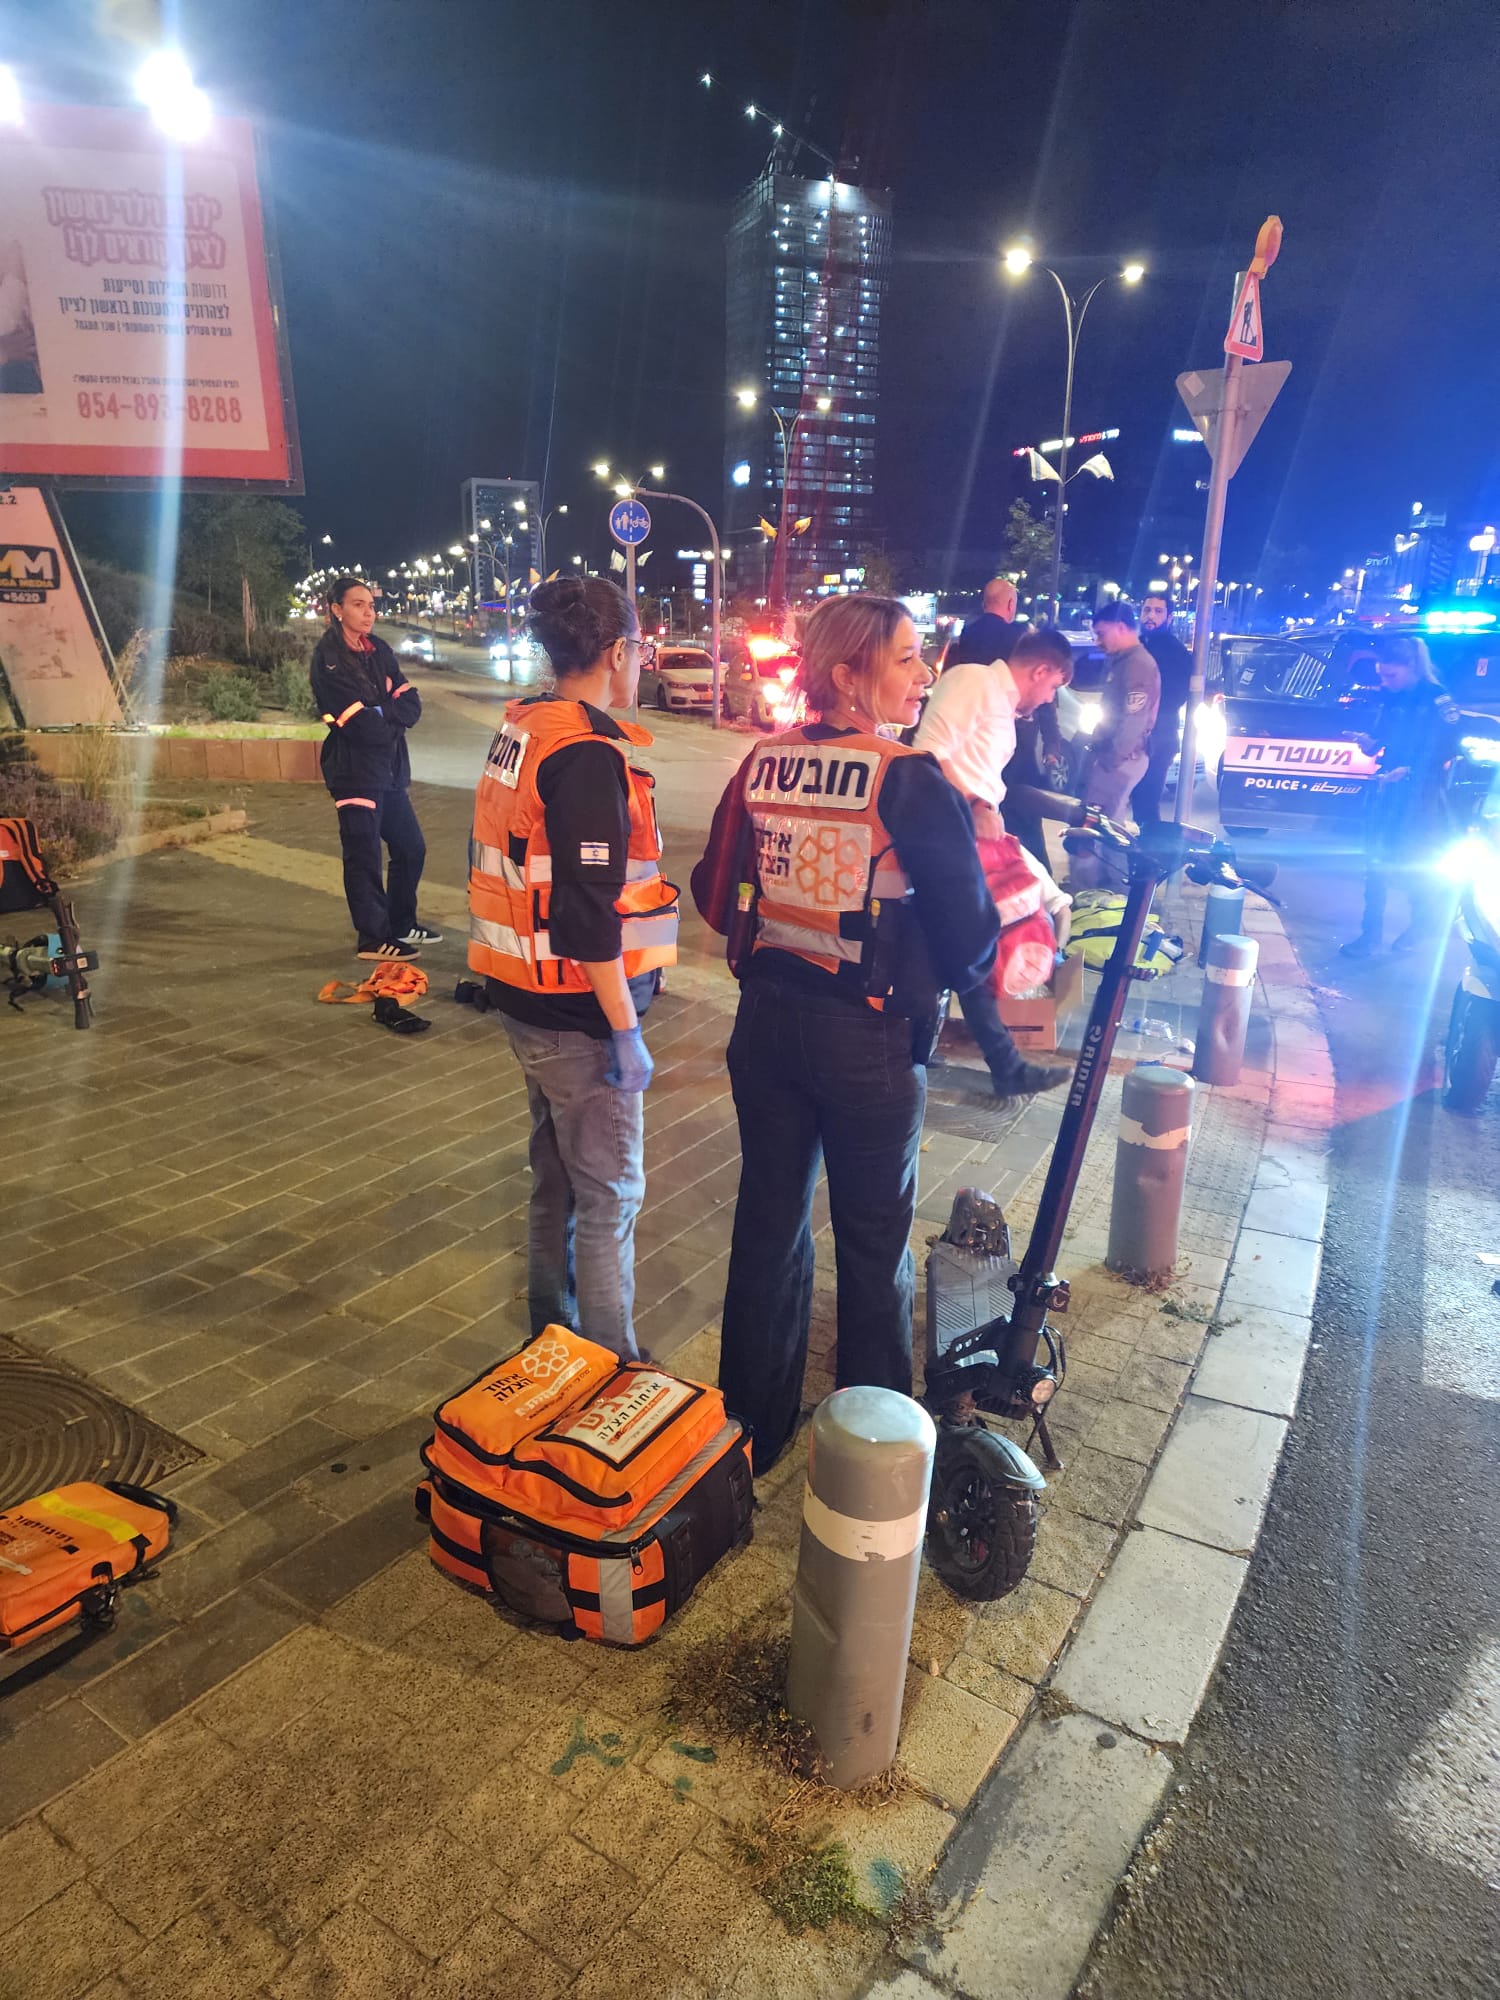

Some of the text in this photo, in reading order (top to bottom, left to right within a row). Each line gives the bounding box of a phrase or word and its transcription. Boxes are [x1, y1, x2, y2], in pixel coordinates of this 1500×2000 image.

[59, 296, 86, 315] לציון
[90, 298, 130, 315] בראשון
[1240, 743, 1354, 765] משטרת
[751, 755, 870, 798] חובשת
[1244, 777, 1300, 791] POLICE
[1310, 781, 1362, 795] شرطة
[1072, 1046, 1096, 1106] RIDER
[482, 1372, 522, 1393] איחוד
[493, 1376, 533, 1402] הצלה
[628, 1382, 662, 1411] איחוד
[597, 1411, 631, 1440] הצלה
